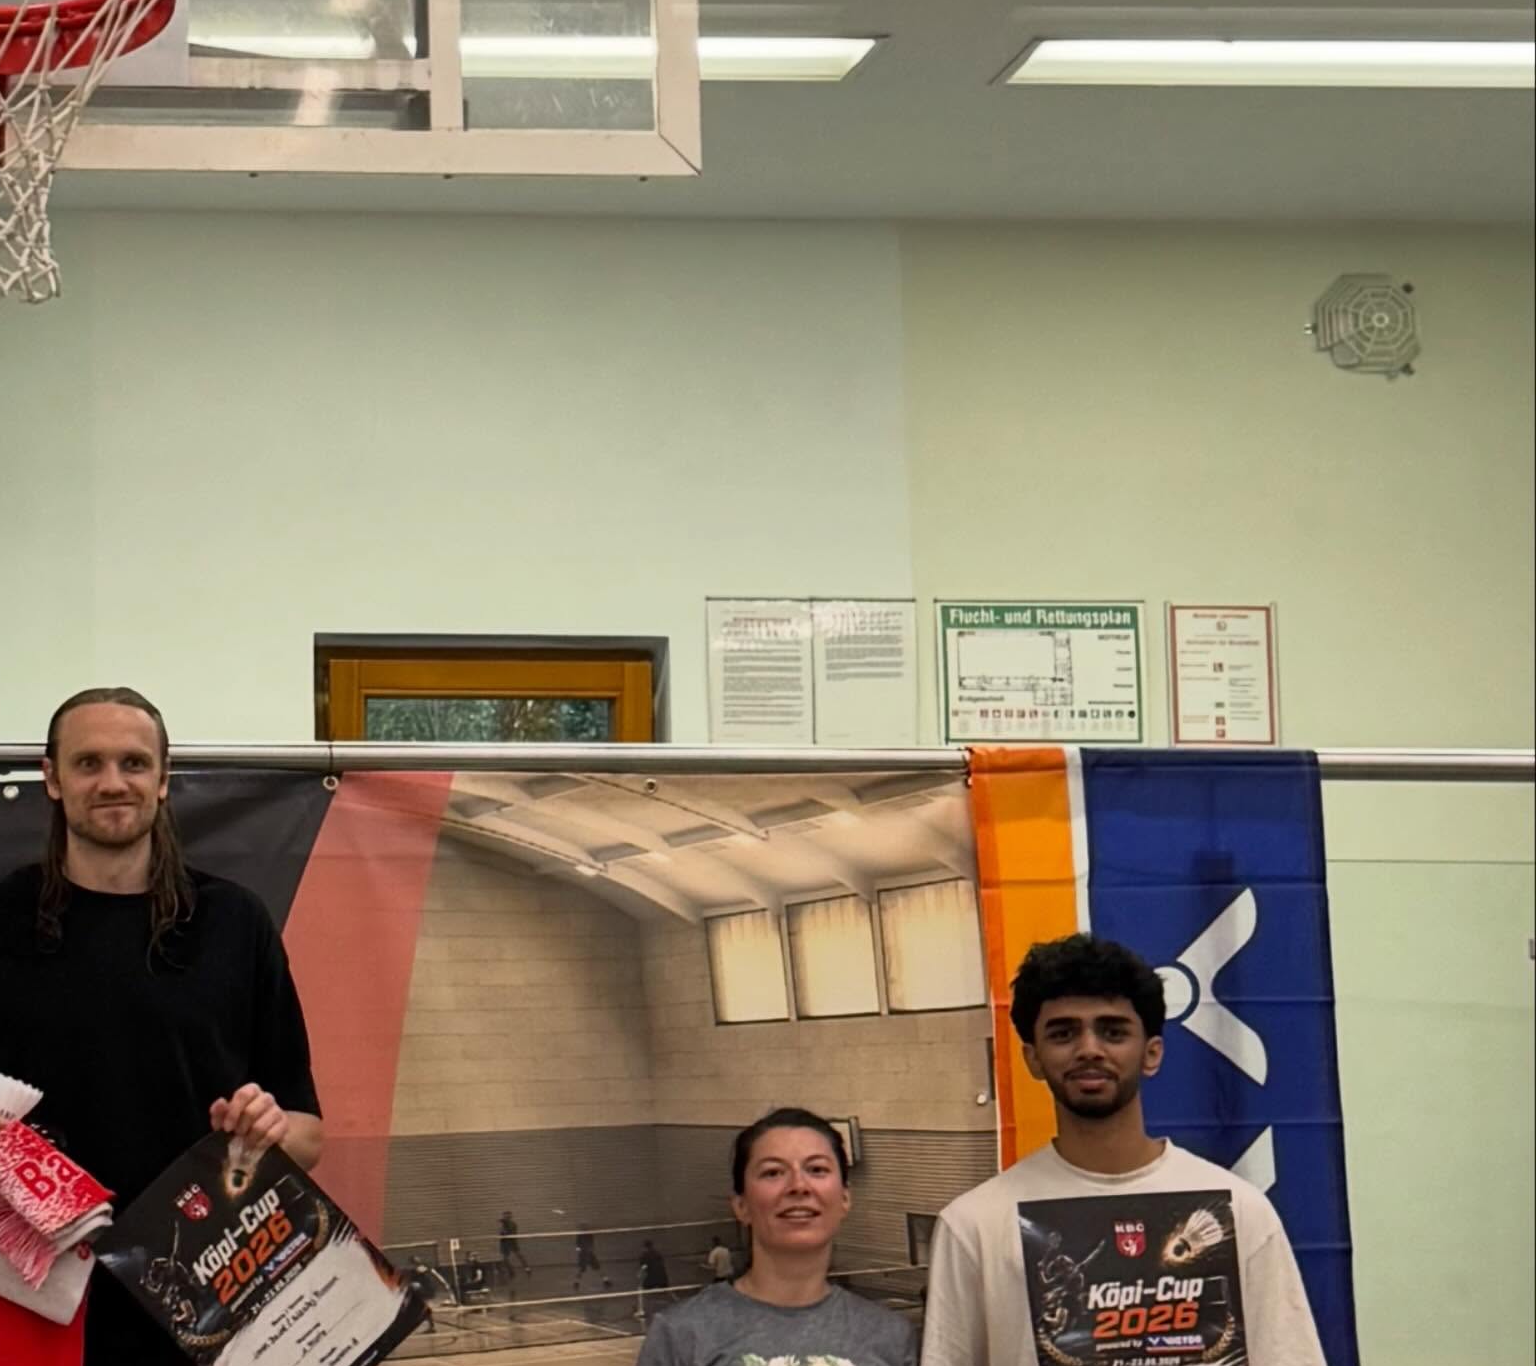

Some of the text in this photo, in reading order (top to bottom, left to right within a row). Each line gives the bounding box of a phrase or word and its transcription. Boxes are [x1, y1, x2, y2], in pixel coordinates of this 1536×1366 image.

[1004, 609, 1032, 625] und
[1036, 609, 1132, 628] Rettungsplan
[192, 1188, 281, 1285] Köpi-Cup
[213, 1209, 293, 1307] 2026
[1088, 1275, 1204, 1310] Köpi-Cup
[1093, 1302, 1199, 1338] 2026
